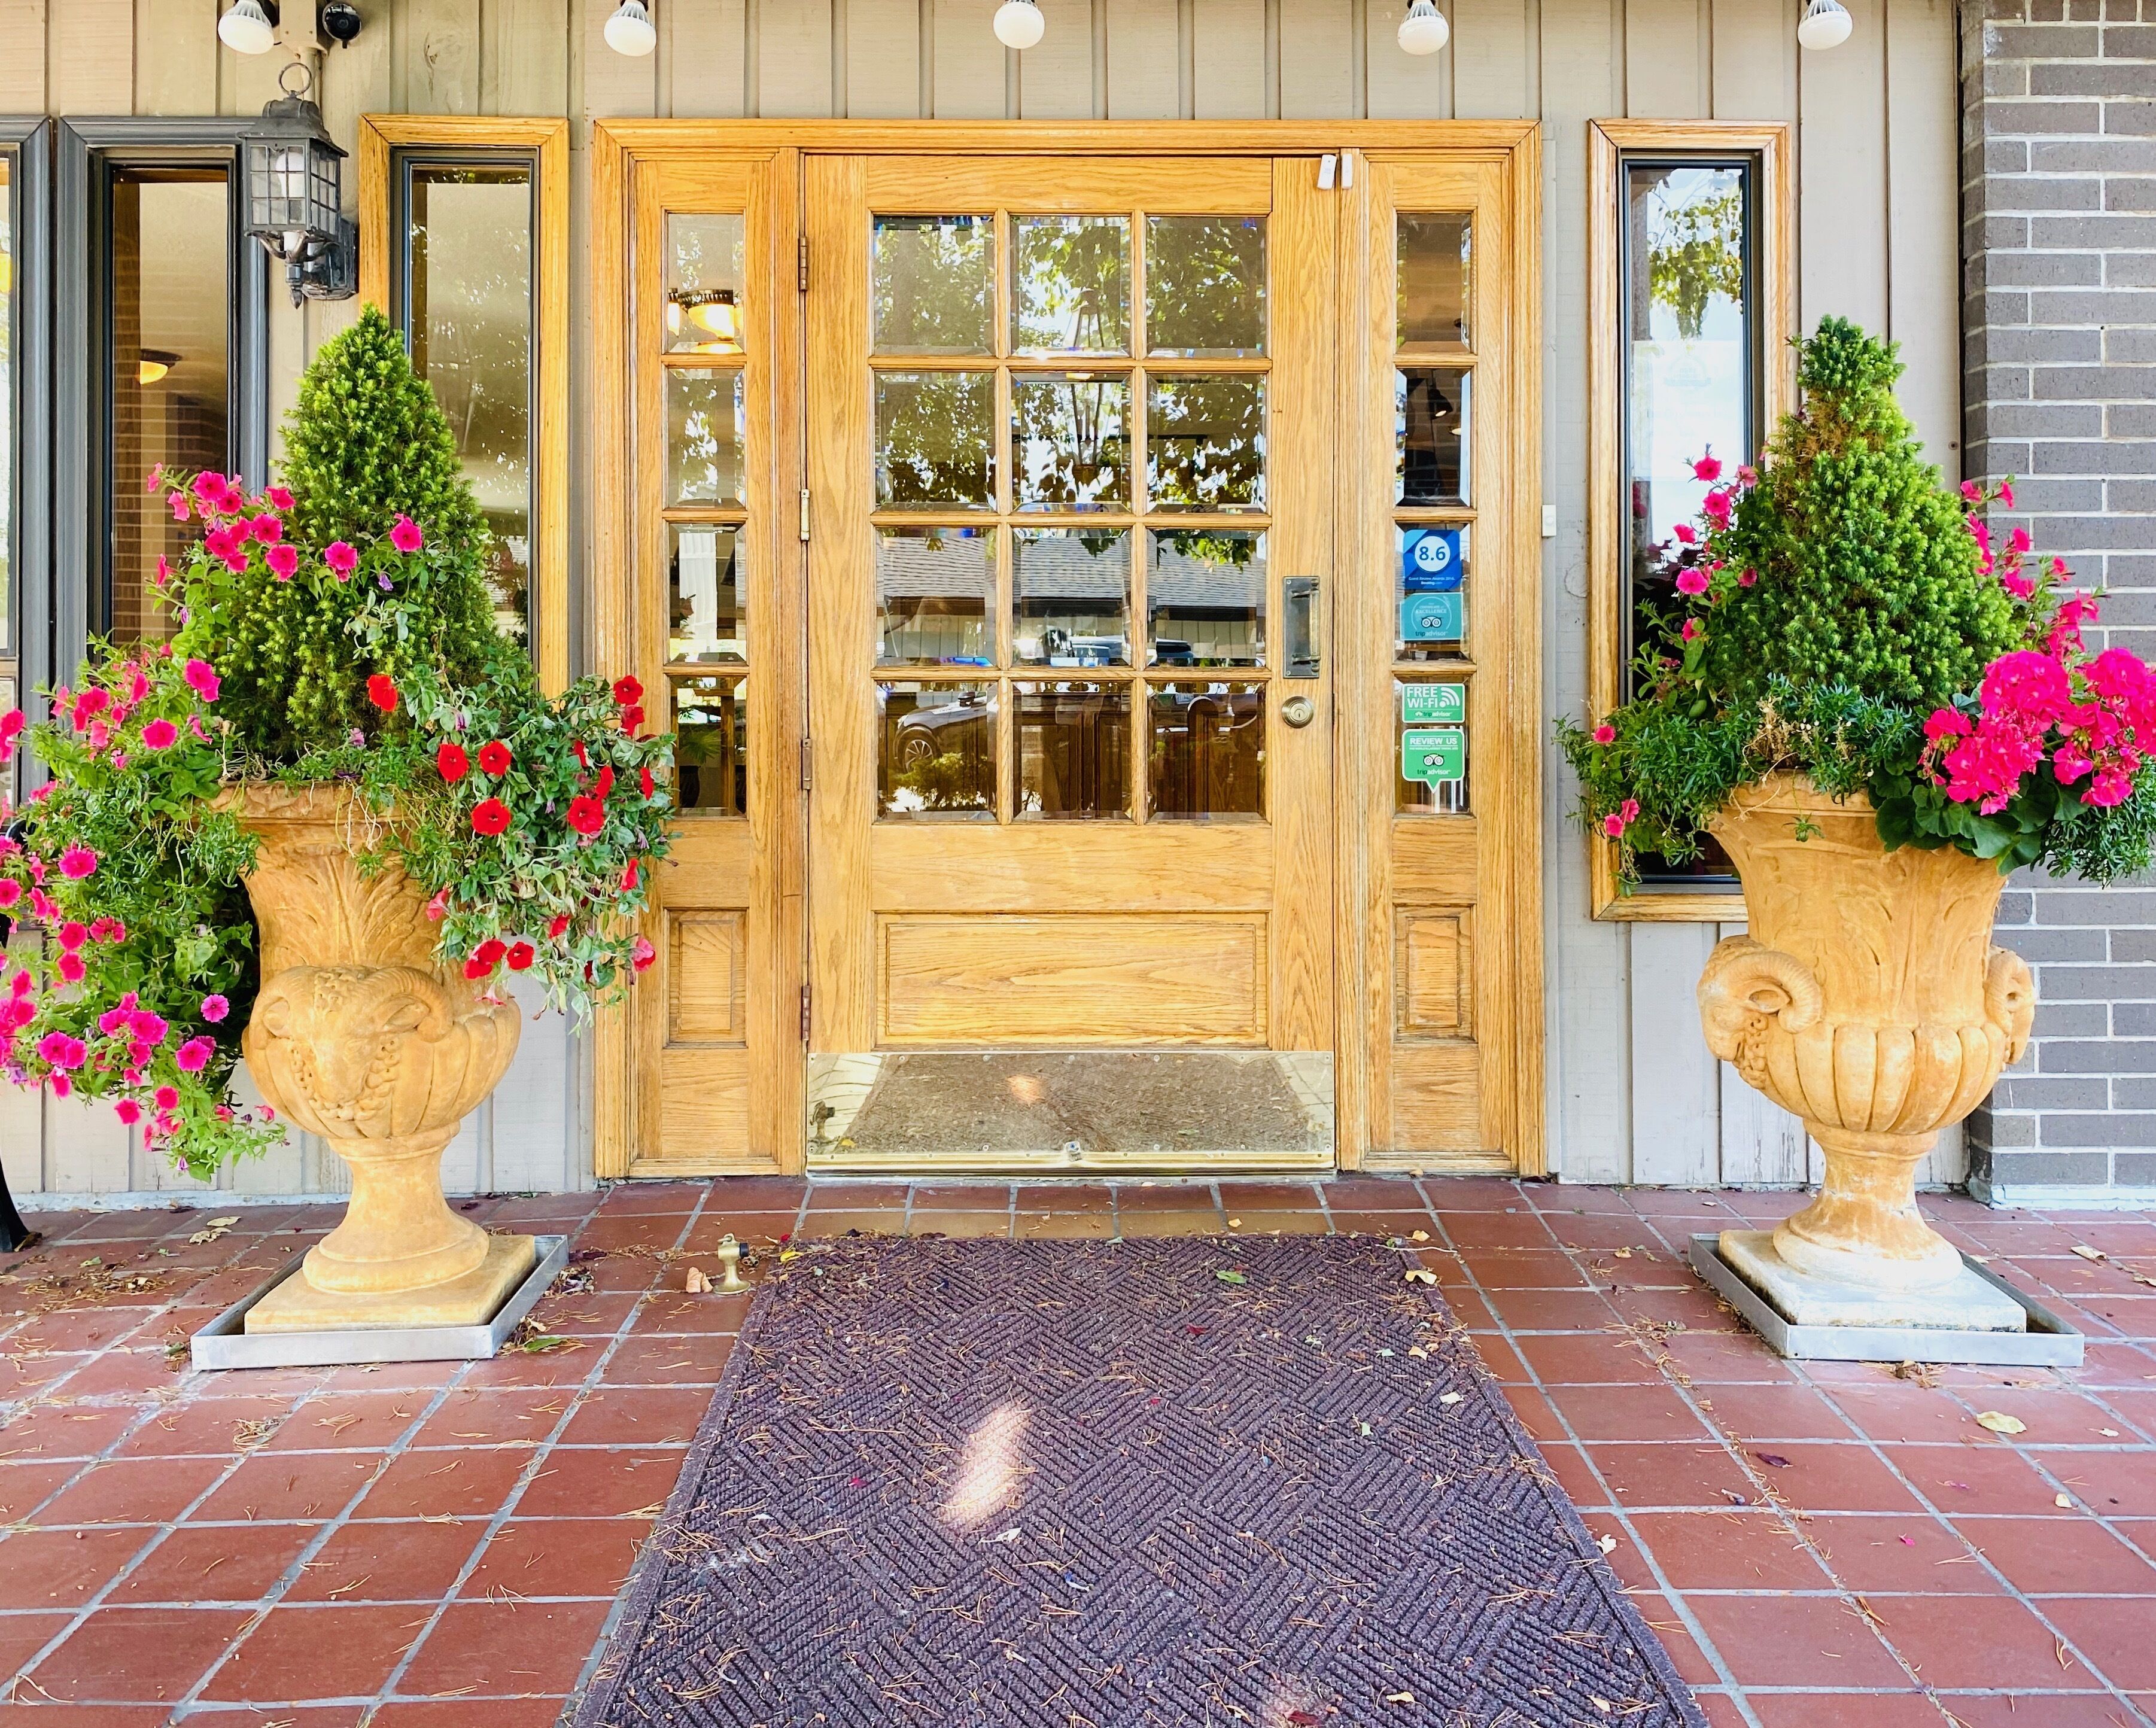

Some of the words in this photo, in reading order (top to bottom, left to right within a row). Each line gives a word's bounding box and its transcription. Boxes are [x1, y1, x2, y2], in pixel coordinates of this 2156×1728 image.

[1419, 546, 1446, 561] 8.6
[1407, 686, 1438, 698] FREE
[1407, 698, 1438, 708] WI-FI
